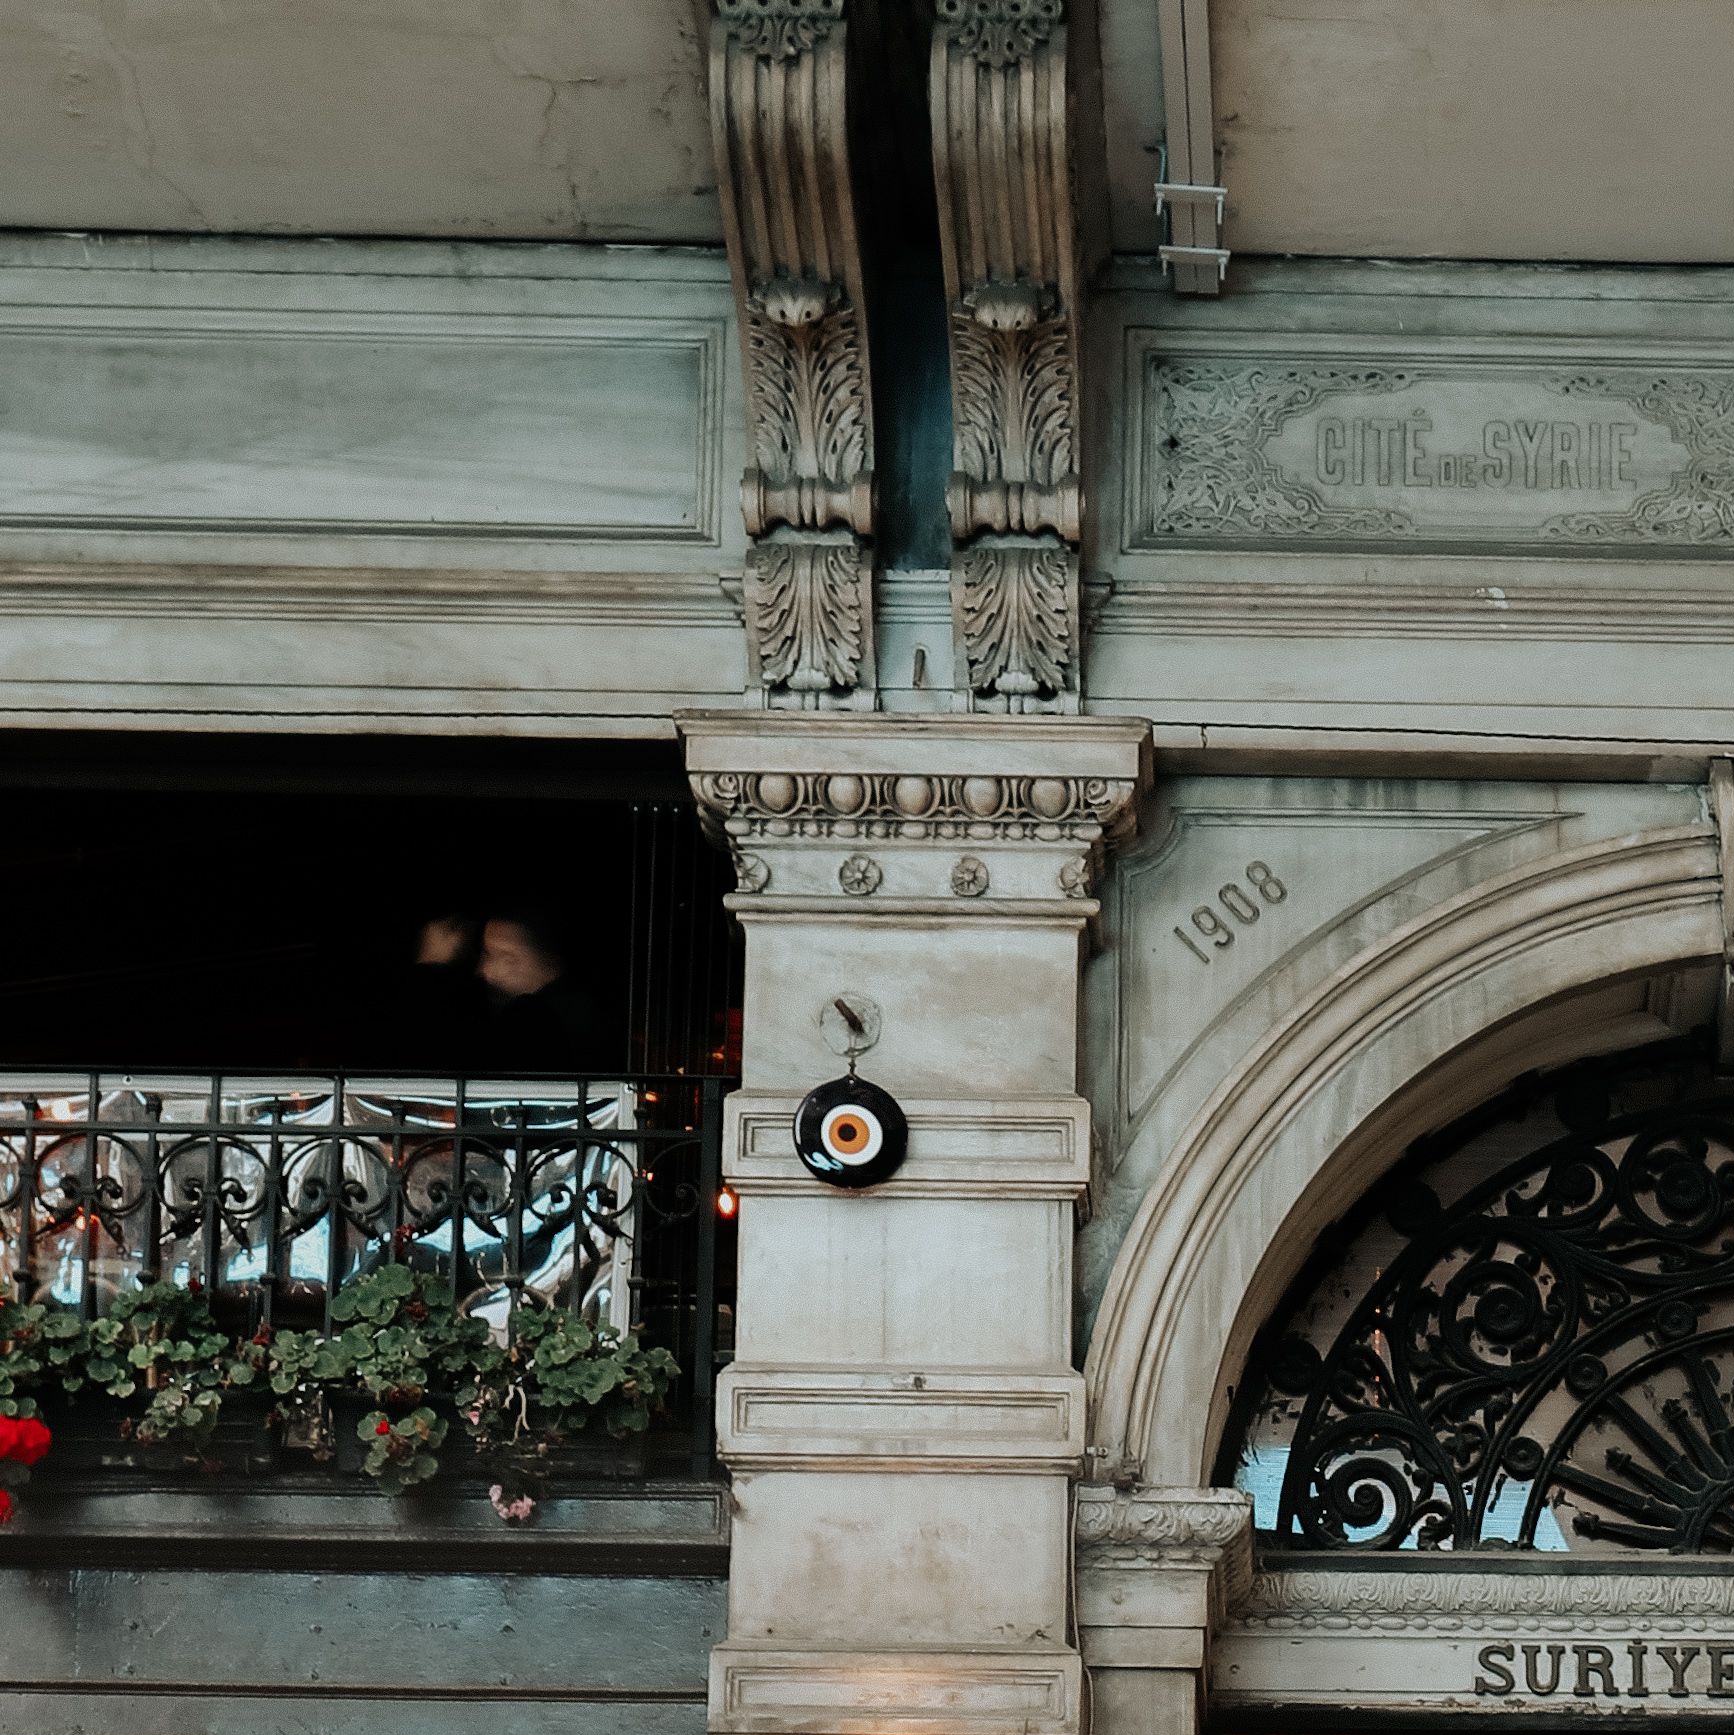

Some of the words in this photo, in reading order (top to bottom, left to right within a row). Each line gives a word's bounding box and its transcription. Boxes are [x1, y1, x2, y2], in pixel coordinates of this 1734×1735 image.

[1315, 408, 1432, 488] CITÉ
[1438, 454, 1476, 488] DE
[1482, 420, 1637, 491] SYRIE
[1173, 860, 1288, 965] 1908
